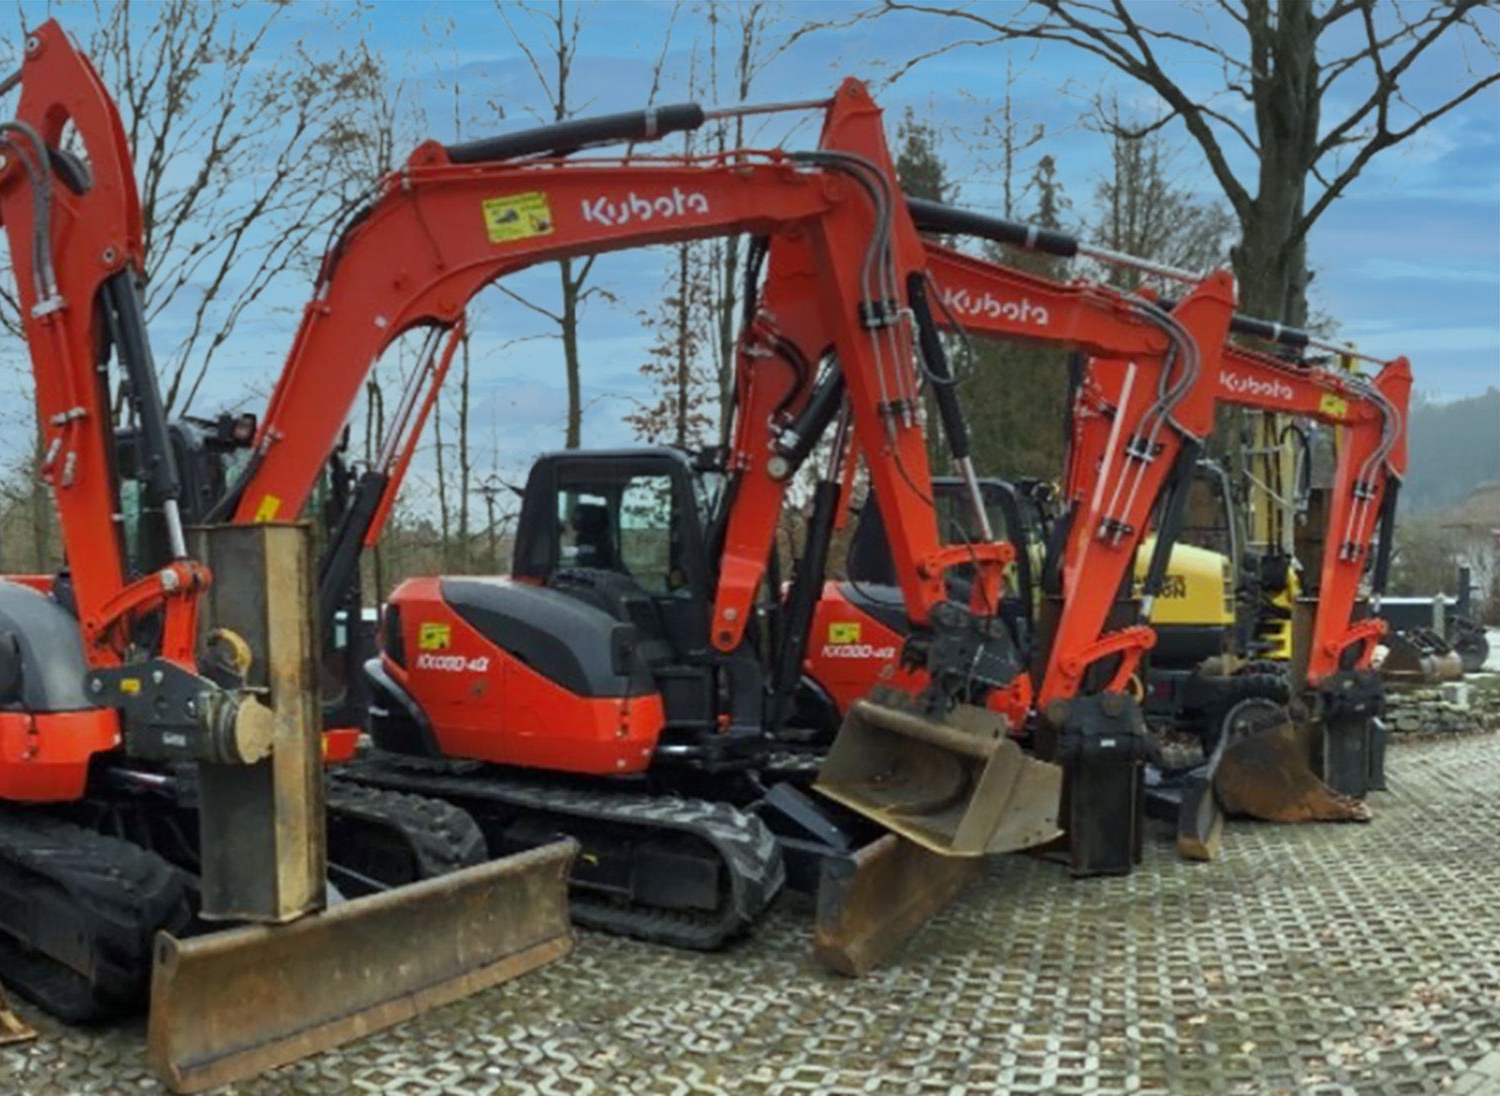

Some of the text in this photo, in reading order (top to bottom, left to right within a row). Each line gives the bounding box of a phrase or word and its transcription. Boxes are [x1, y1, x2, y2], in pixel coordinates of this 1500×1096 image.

[581, 186, 709, 227] Kubota
[942, 287, 1049, 326] Kubota
[1219, 371, 1294, 400] Kubota
